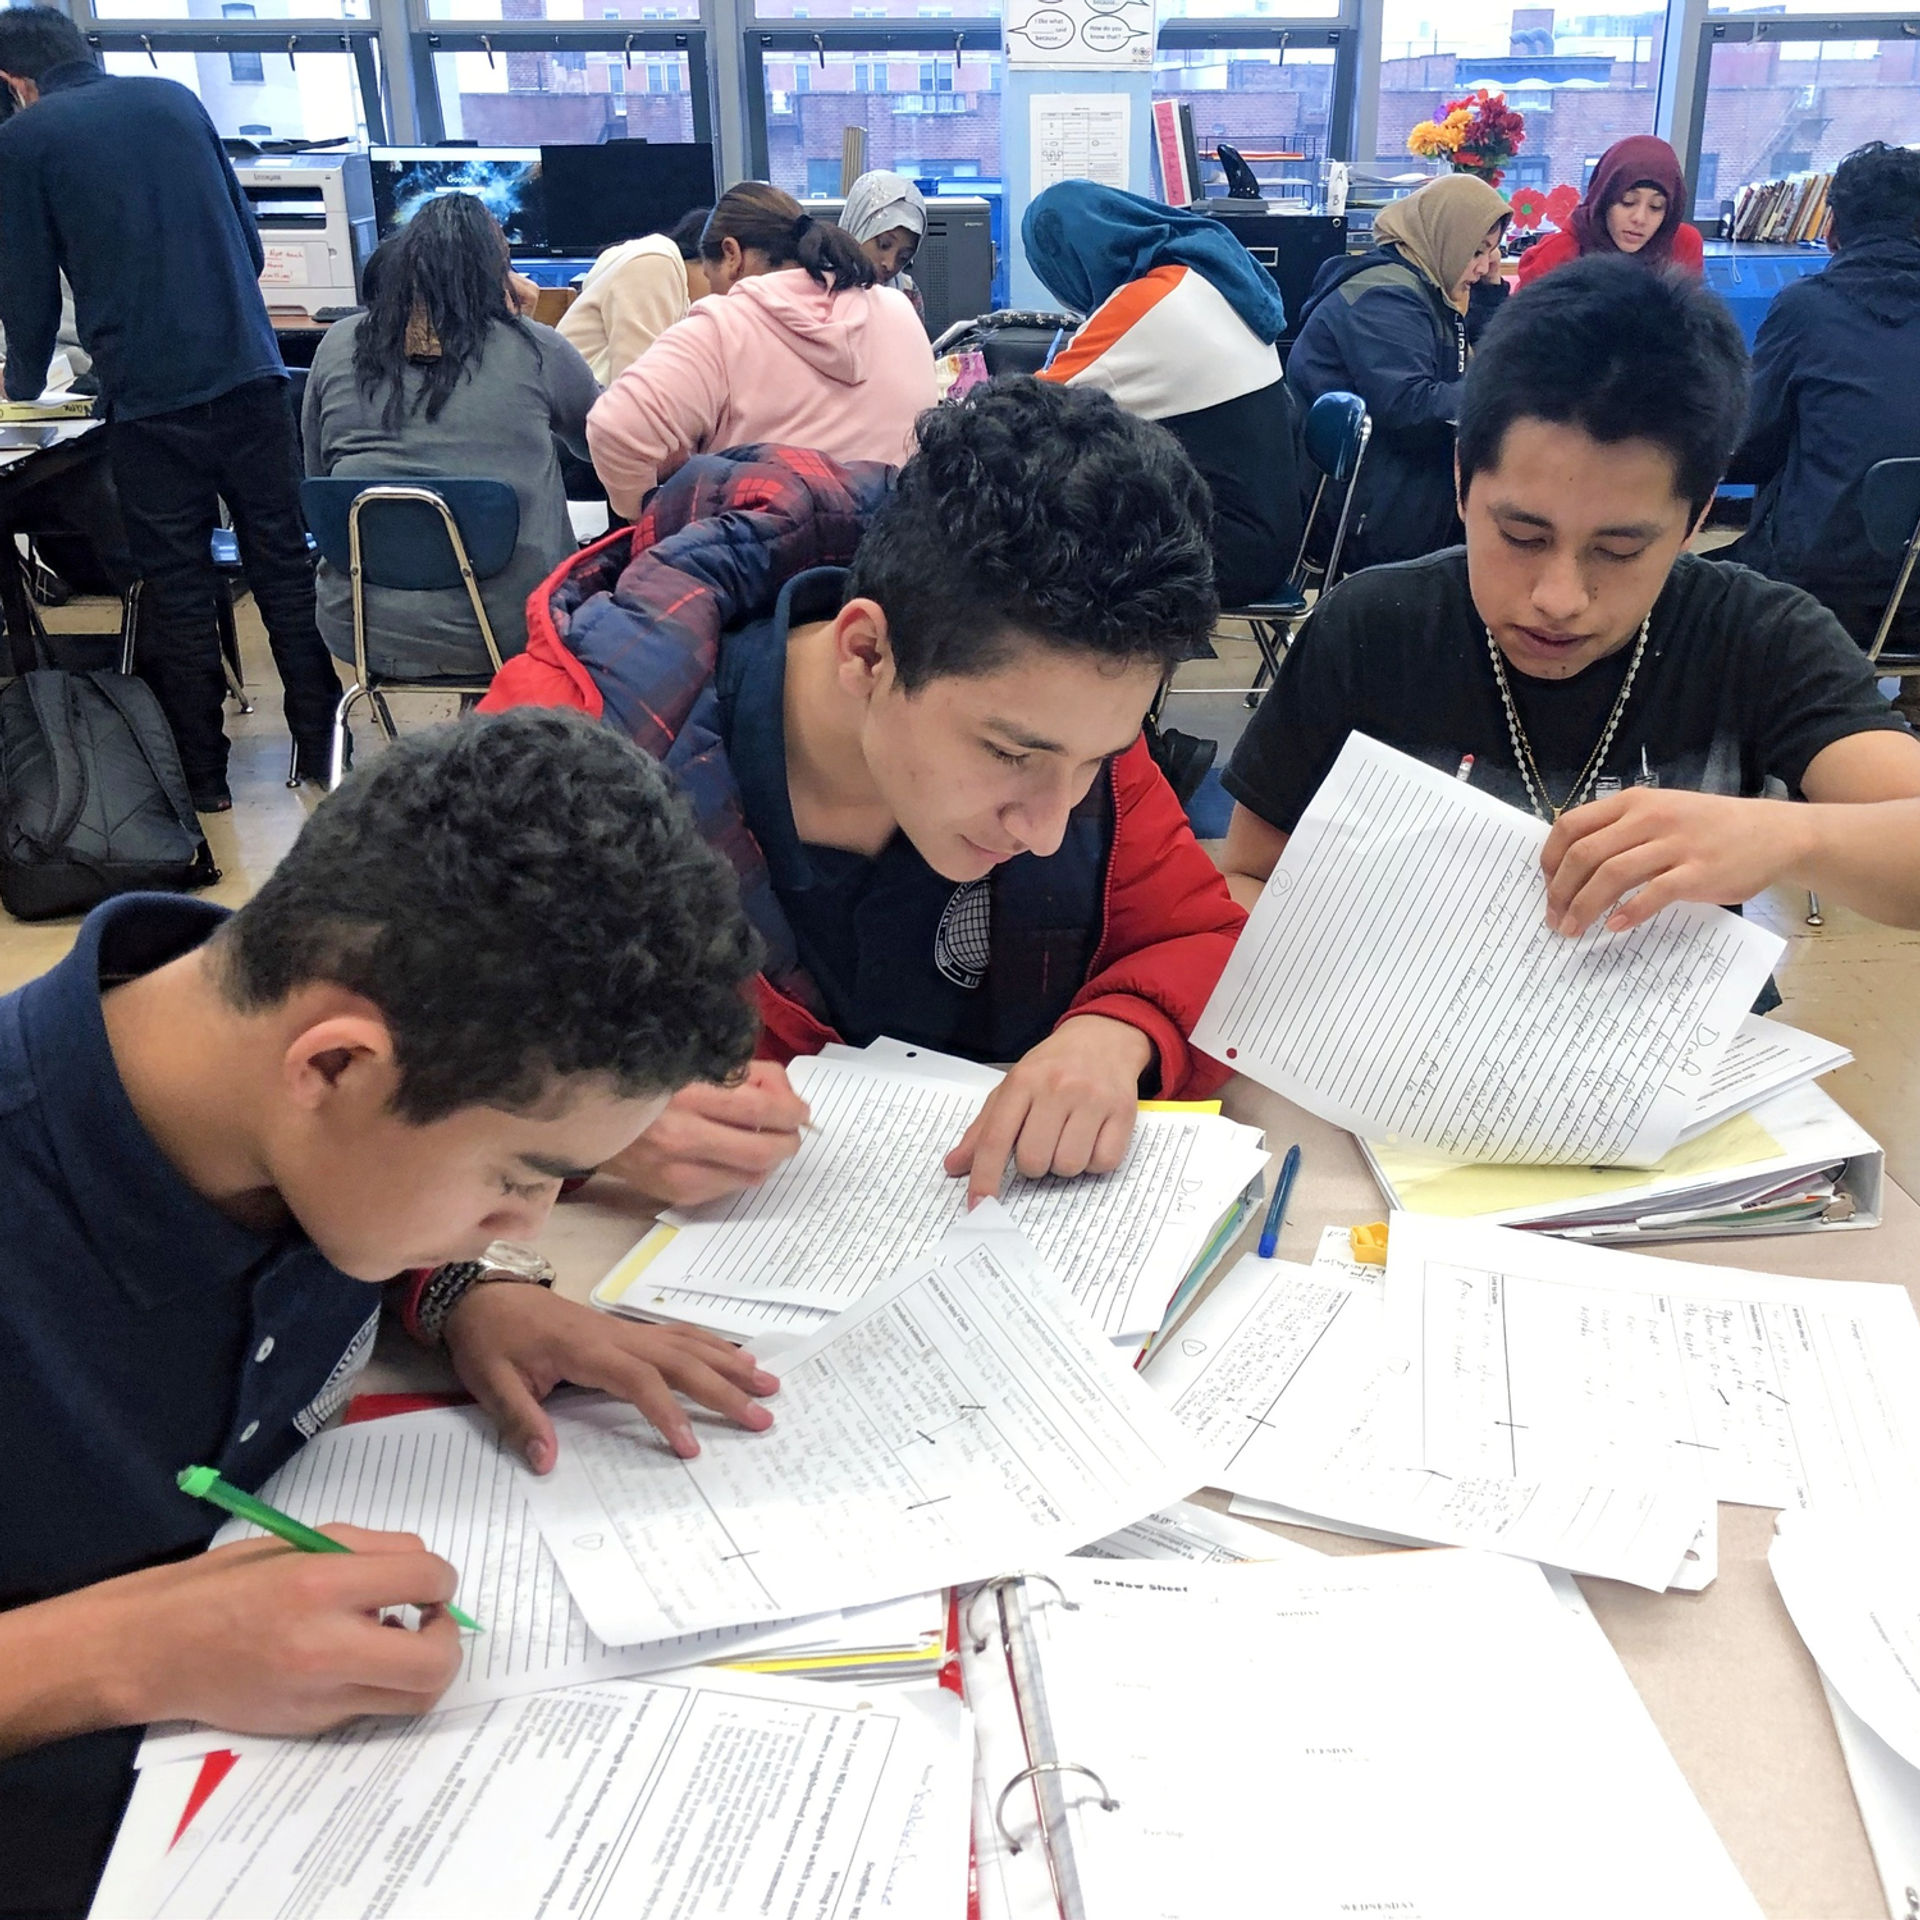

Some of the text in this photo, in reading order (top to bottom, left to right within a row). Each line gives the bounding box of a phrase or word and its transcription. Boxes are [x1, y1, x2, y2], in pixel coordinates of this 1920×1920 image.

[1674, 1021, 1723, 1080] Draft
[1115, 1580, 1144, 1590] Now
[1149, 1584, 1188, 1593] Sheet
[793, 1758, 825, 1819] neighborhood
[782, 1817, 803, 1854] become
[812, 1795, 838, 1843] paragraph
